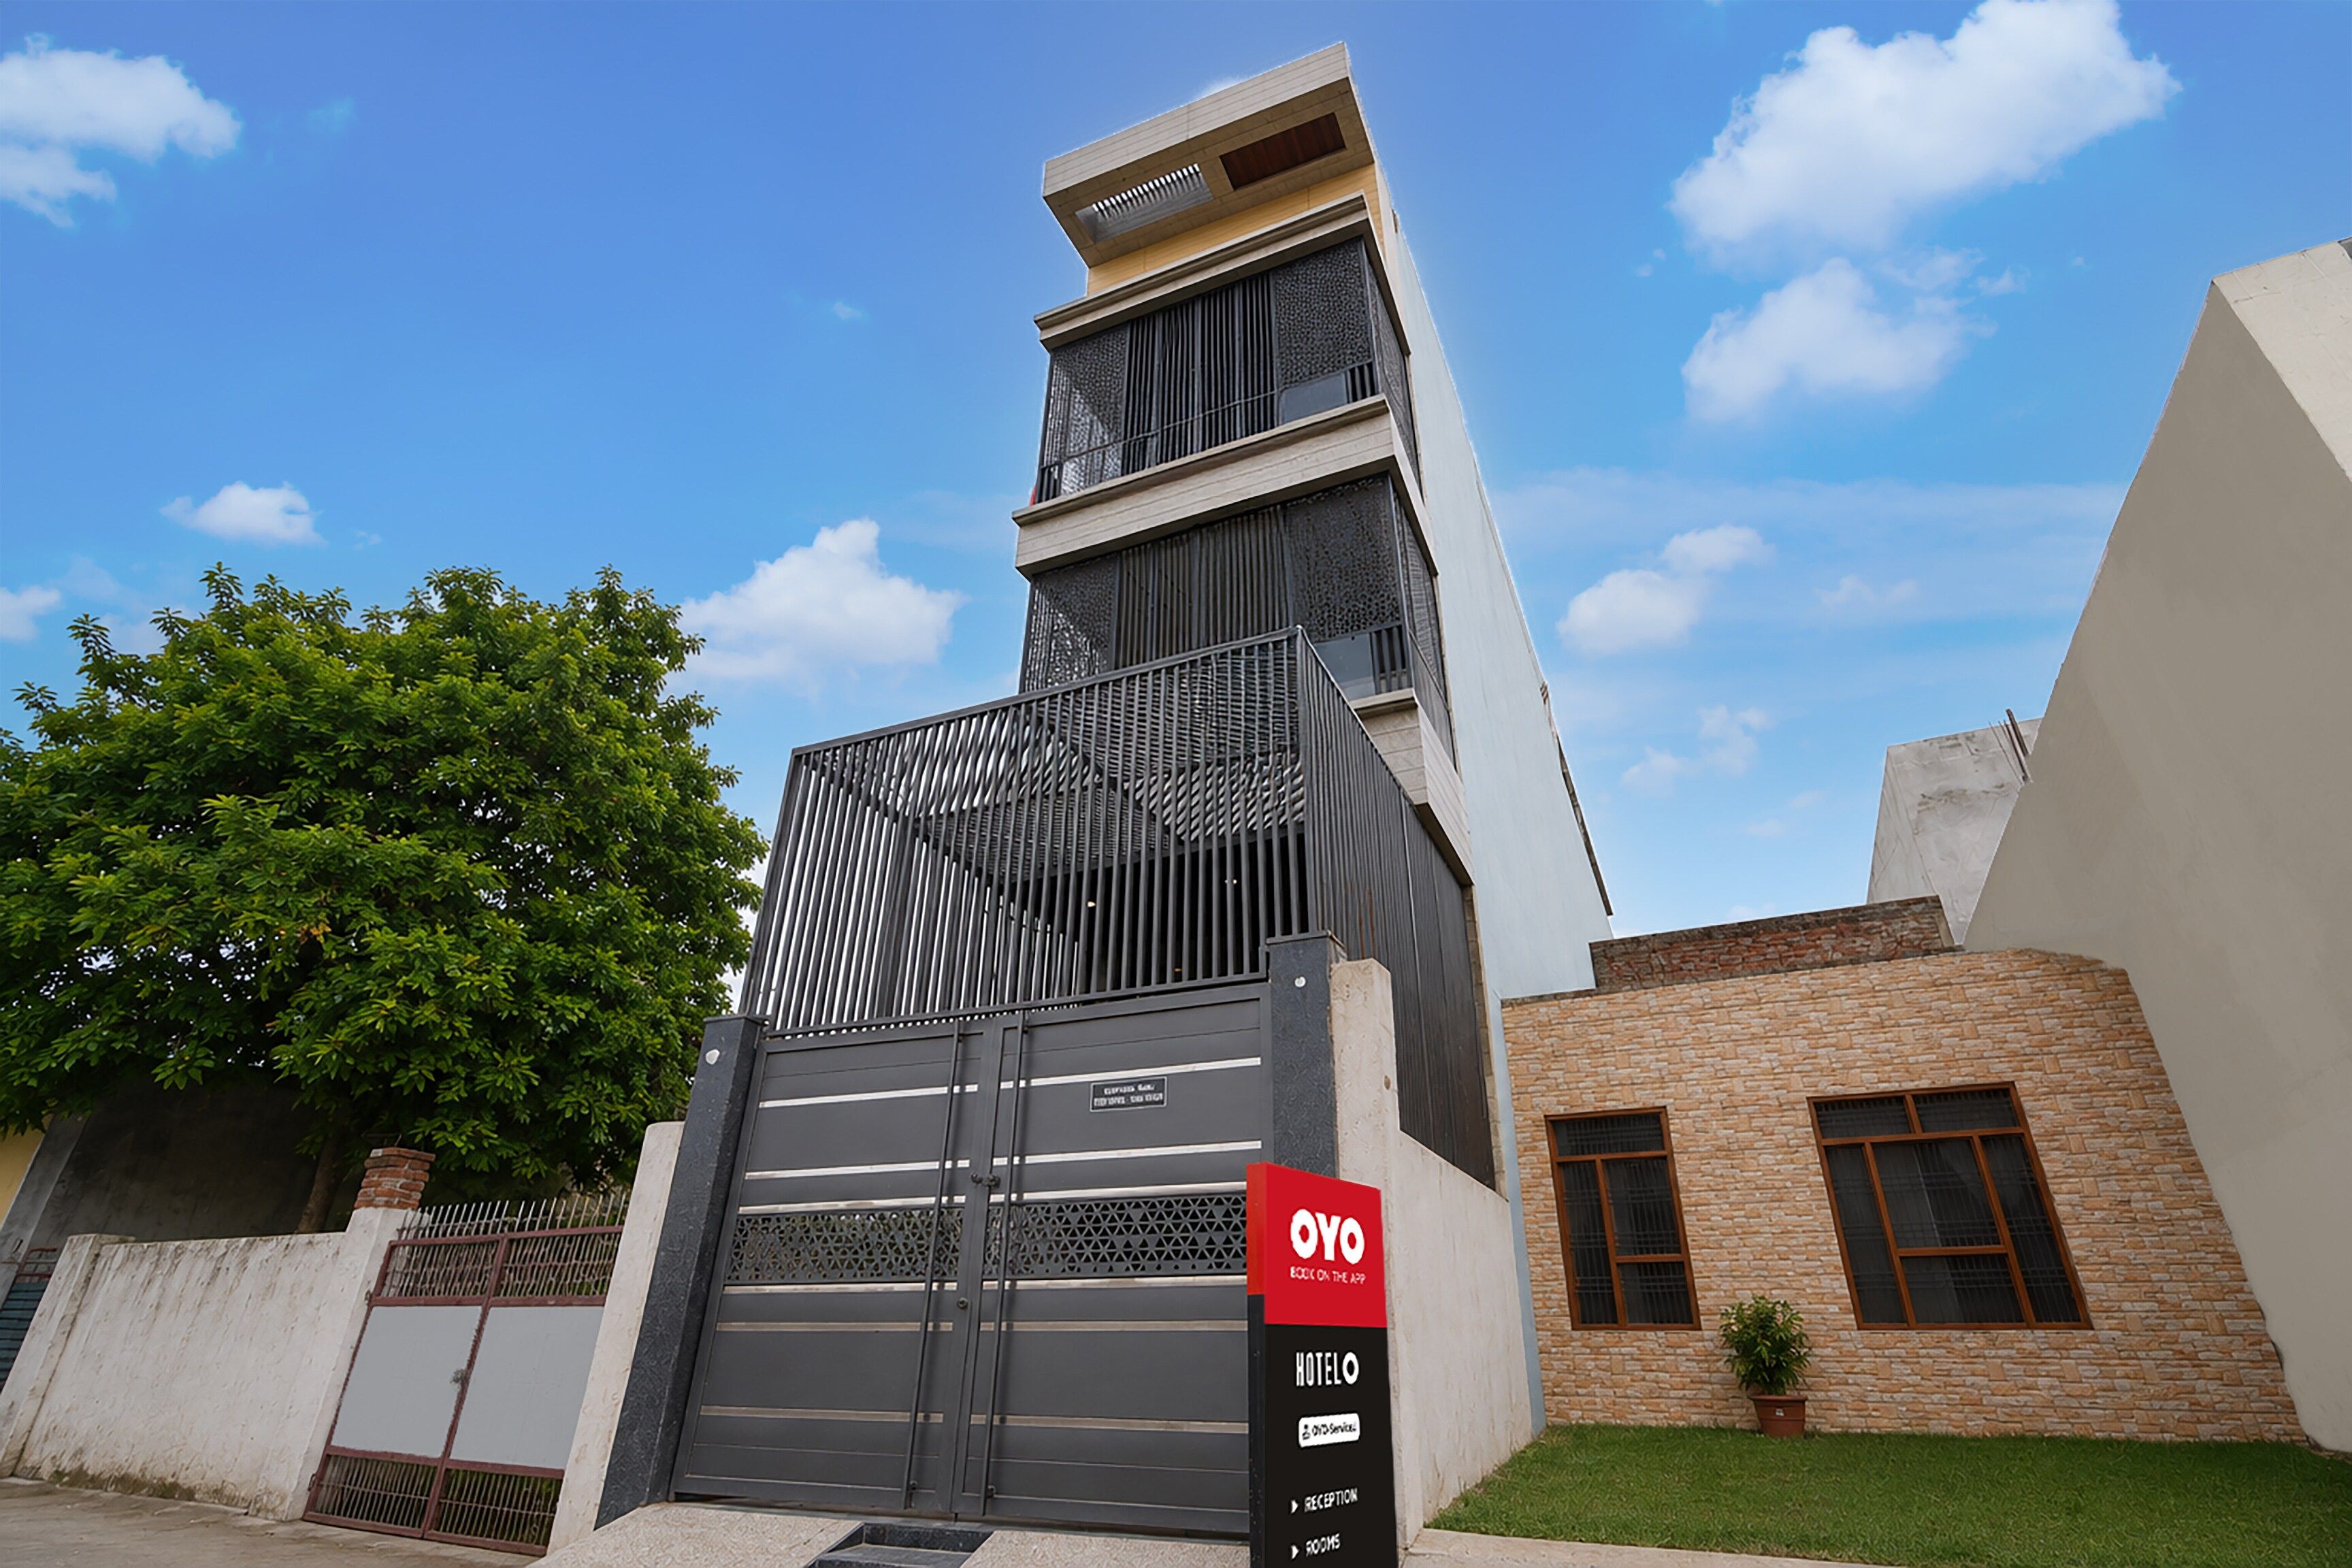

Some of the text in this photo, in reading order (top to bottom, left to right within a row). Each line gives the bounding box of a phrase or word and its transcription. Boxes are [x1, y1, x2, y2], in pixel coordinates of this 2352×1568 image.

[1290, 1209, 1365, 1264] OYO
[1317, 1269, 1330, 1281] ON
[1332, 1271, 1348, 1284] THE
[1350, 1273, 1366, 1284] APP
[1305, 1488, 1358, 1512] RECEPTION
[1306, 1533, 1340, 1557] ROOMS
